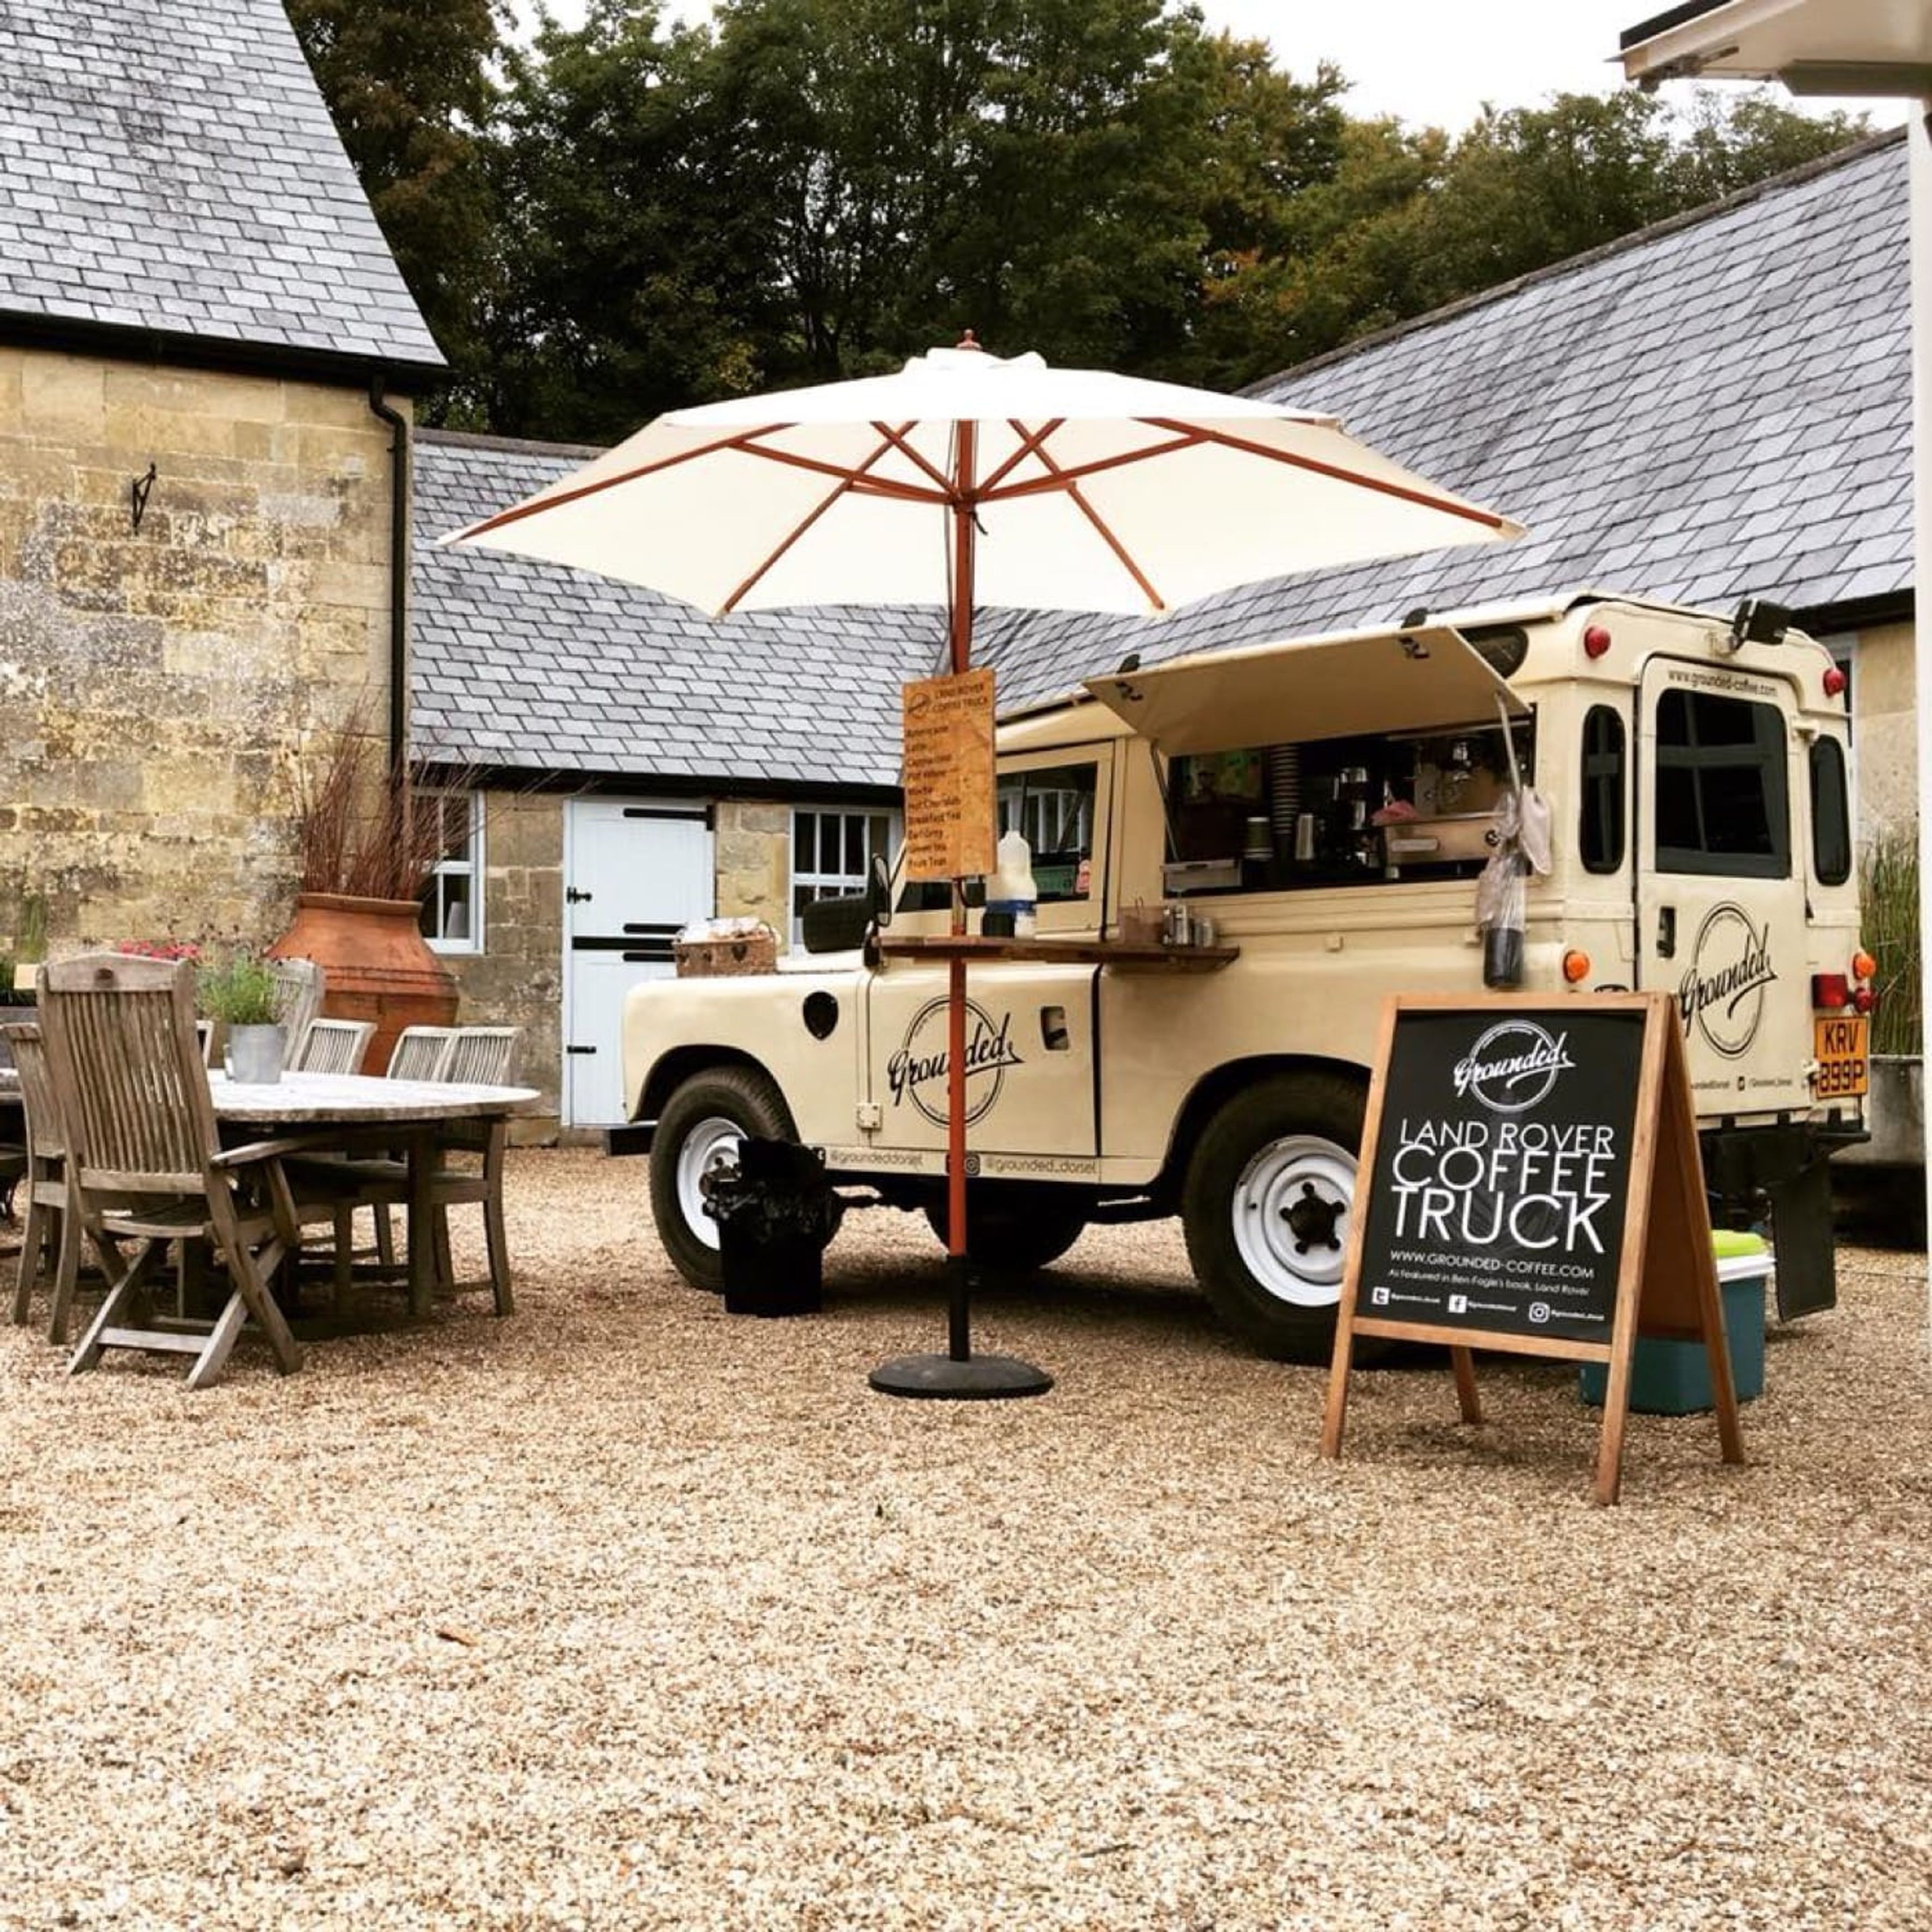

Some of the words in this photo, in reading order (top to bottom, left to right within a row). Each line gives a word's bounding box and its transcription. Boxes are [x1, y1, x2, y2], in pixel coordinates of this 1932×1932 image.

[1824, 1023, 1859, 1054] KRV
[888, 1012, 1025, 1106] Grouded
[1454, 1031, 1576, 1098] Grounded
[1819, 1060, 1864, 1091] 899P
[1400, 1119, 1488, 1148] LAND
[1499, 1122, 1614, 1155] ROVER
[1392, 1145, 1615, 1198] COFFEE
[1391, 1185, 1611, 1253] TRUCK
[1390, 1250, 1594, 1279] WWW.GROUNDED-COFFEE.COM
[1535, 1282, 1560, 1294] Land
